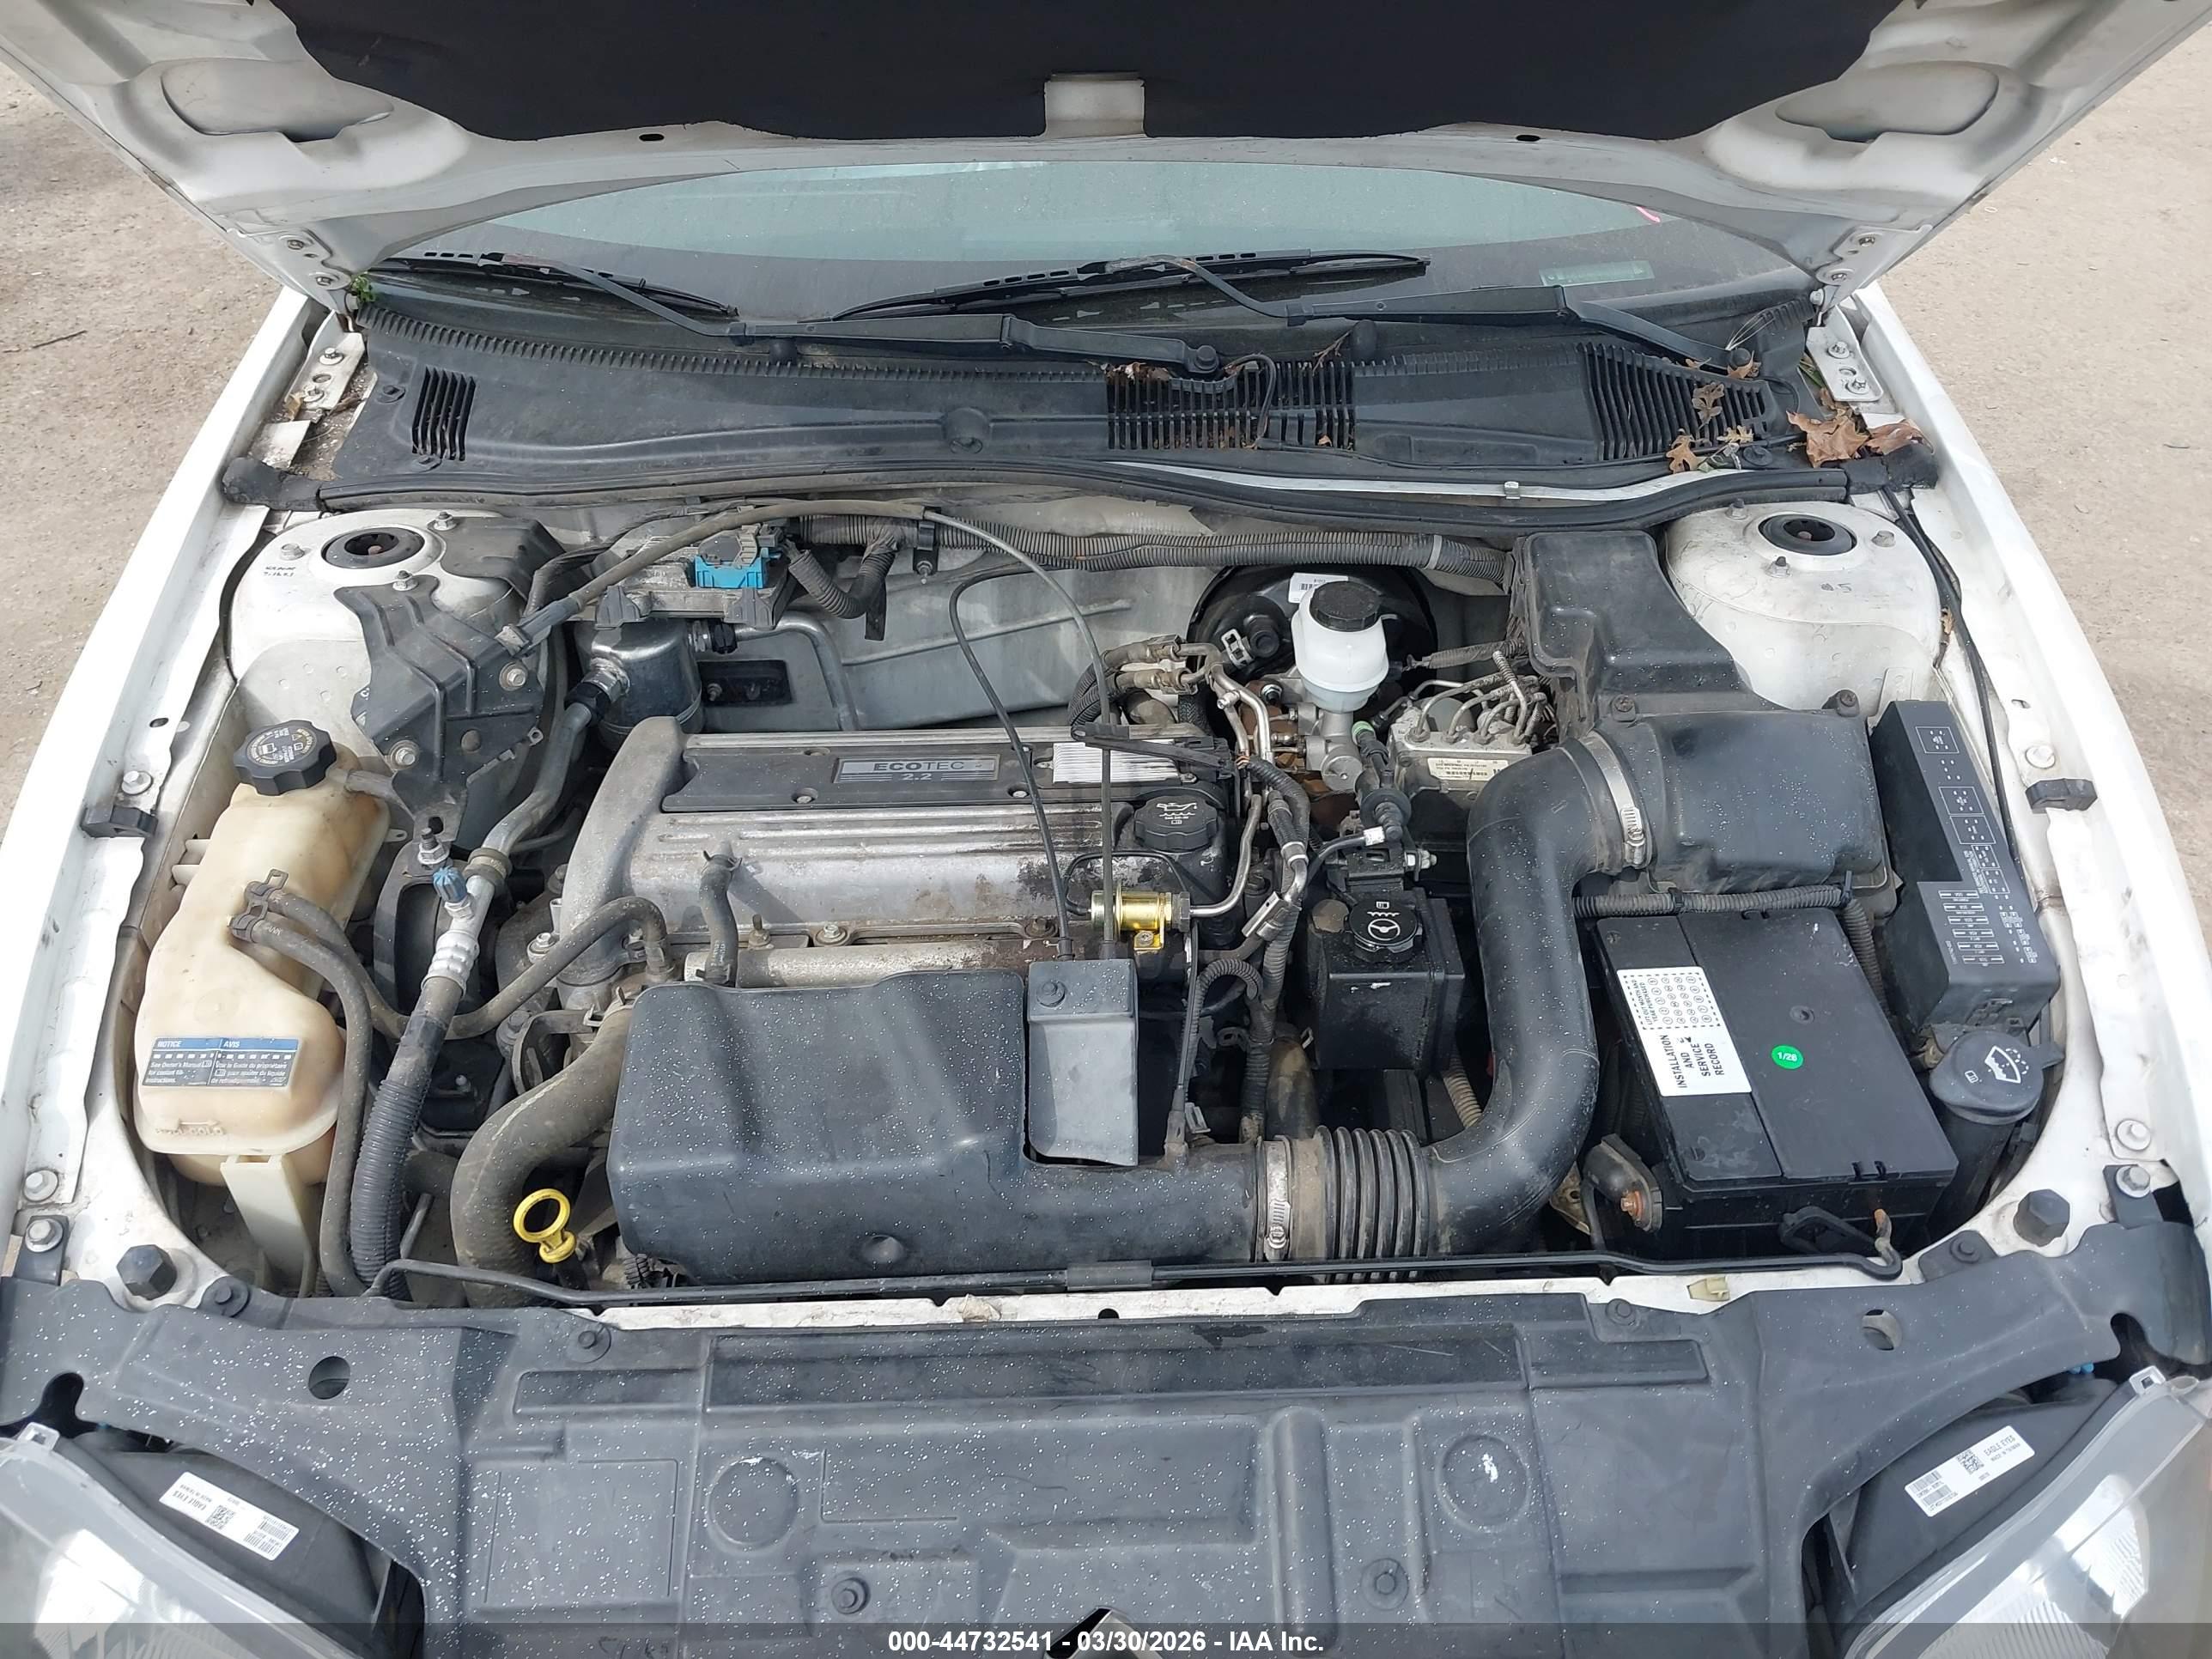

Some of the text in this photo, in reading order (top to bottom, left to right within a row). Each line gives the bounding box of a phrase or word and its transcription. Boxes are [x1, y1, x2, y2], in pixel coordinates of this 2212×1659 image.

[873, 761, 964, 771] ECOTEC
[1659, 1034, 1688, 1088] INSTALLATION
[1680, 1052, 1694, 1068] AND
[1691, 1043, 1711, 1077] SERVICE
[1704, 1043, 1725, 1075] RECORD
